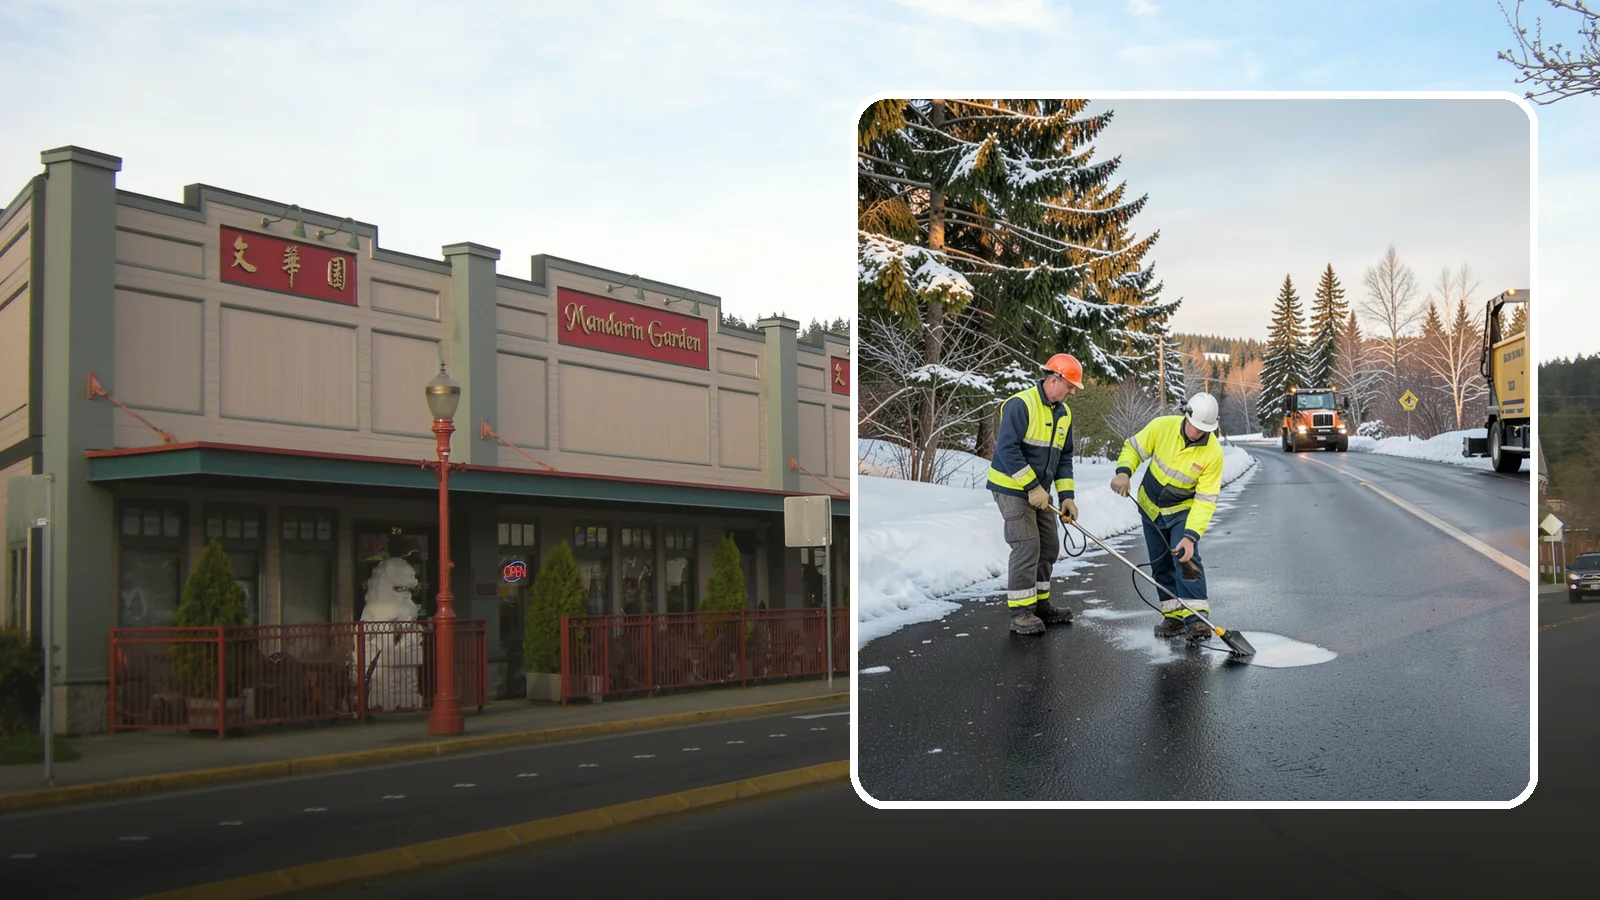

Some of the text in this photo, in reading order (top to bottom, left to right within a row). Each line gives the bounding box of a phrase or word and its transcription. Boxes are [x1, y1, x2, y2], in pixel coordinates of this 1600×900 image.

[564, 302, 702, 353] Mandarin Garden
[503, 565, 528, 578] OPEN
